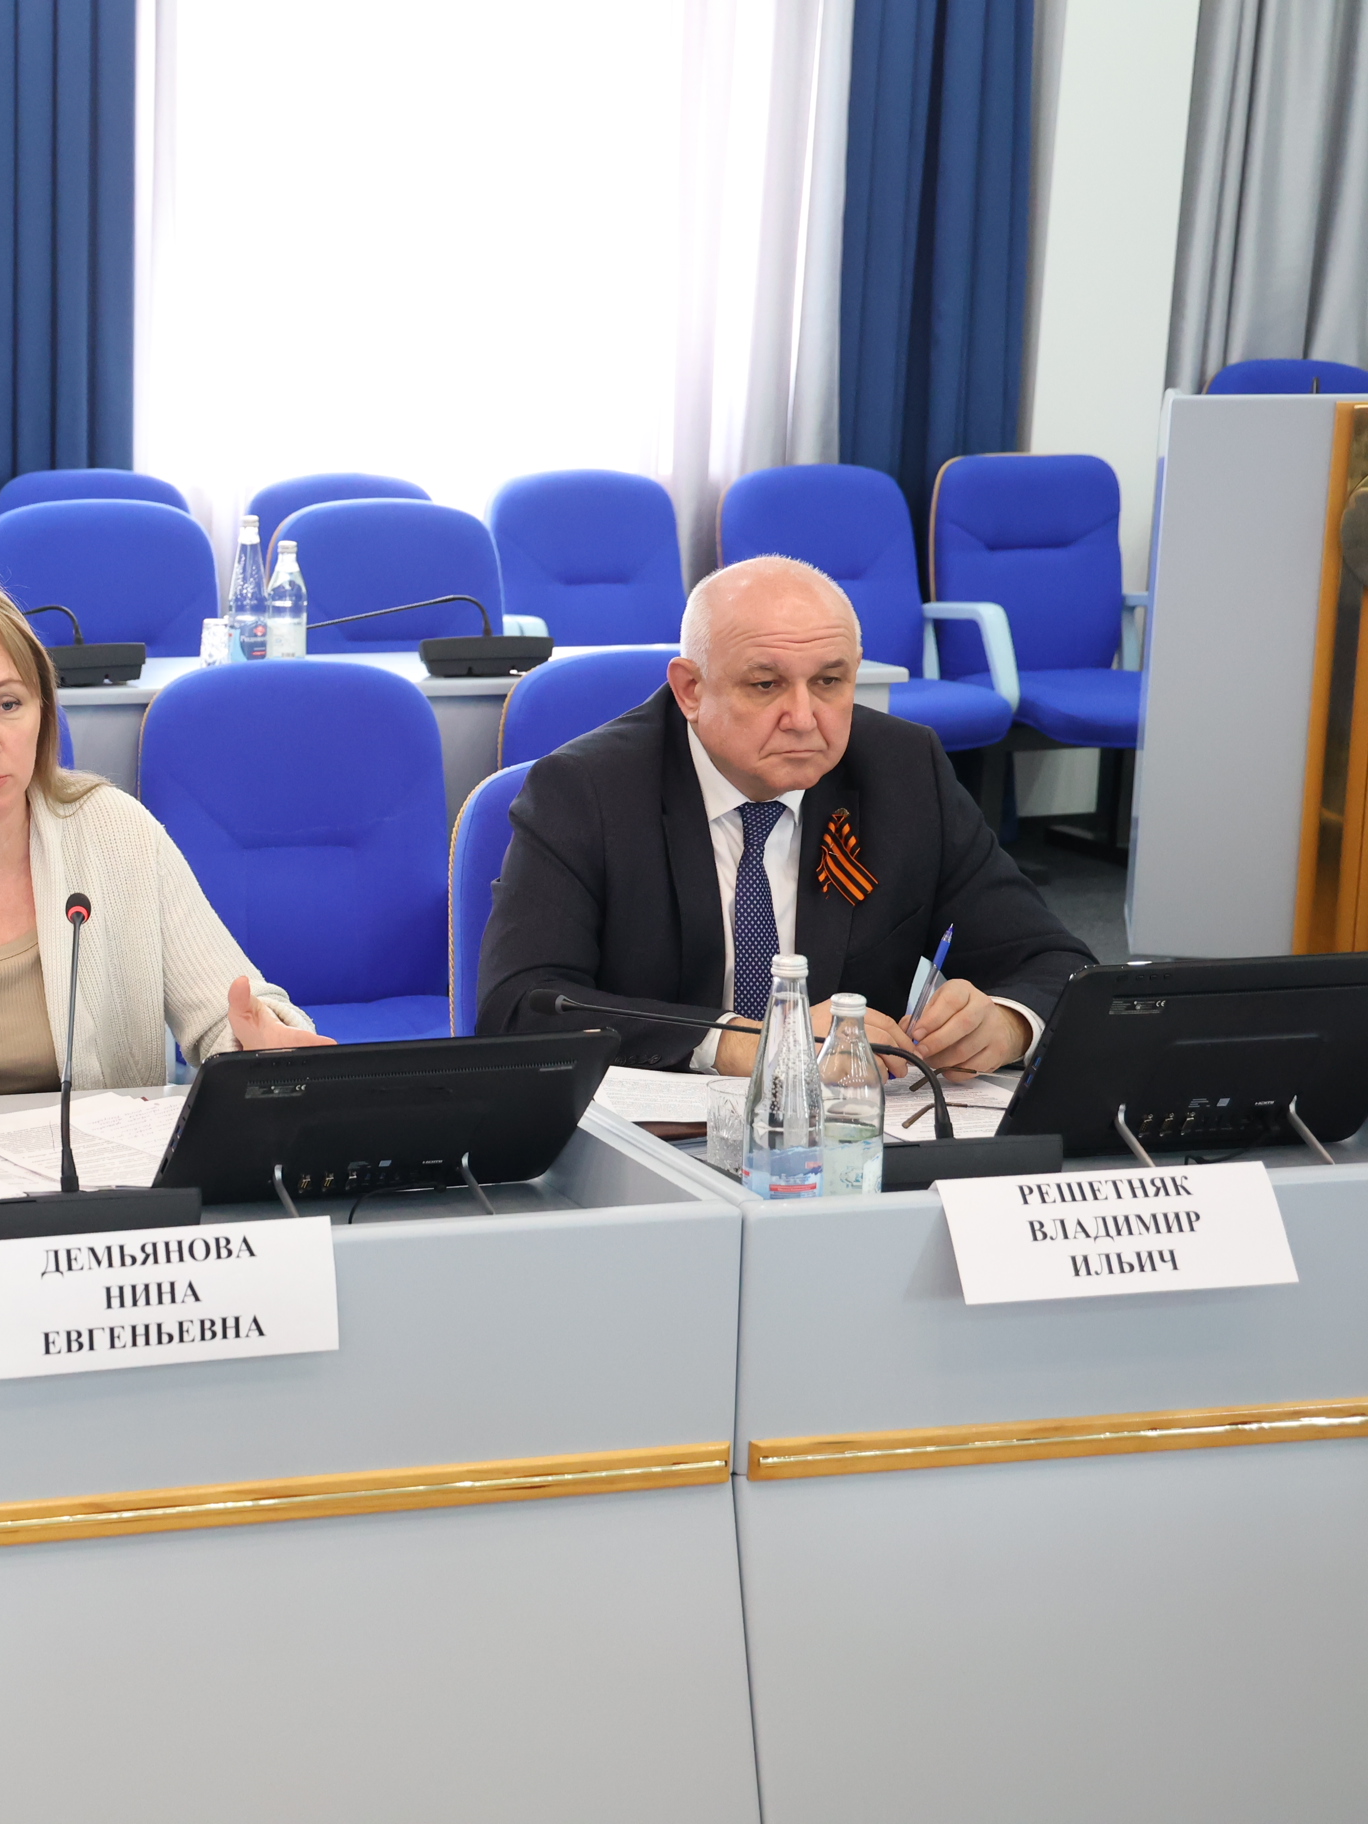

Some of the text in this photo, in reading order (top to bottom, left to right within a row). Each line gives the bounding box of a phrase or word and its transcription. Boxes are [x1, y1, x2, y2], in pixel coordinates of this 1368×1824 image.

[1017, 1175, 1193, 1205] РЕШЕТНЯК
[1026, 1211, 1201, 1243] ВЛАДИМИР
[41, 1235, 257, 1279] ДЕМЬЯНОВА
[1070, 1249, 1180, 1277] ИЛЬИЧ
[103, 1280, 202, 1310] НИНА
[42, 1315, 267, 1356] ЕВГЕНЬЕВНА
